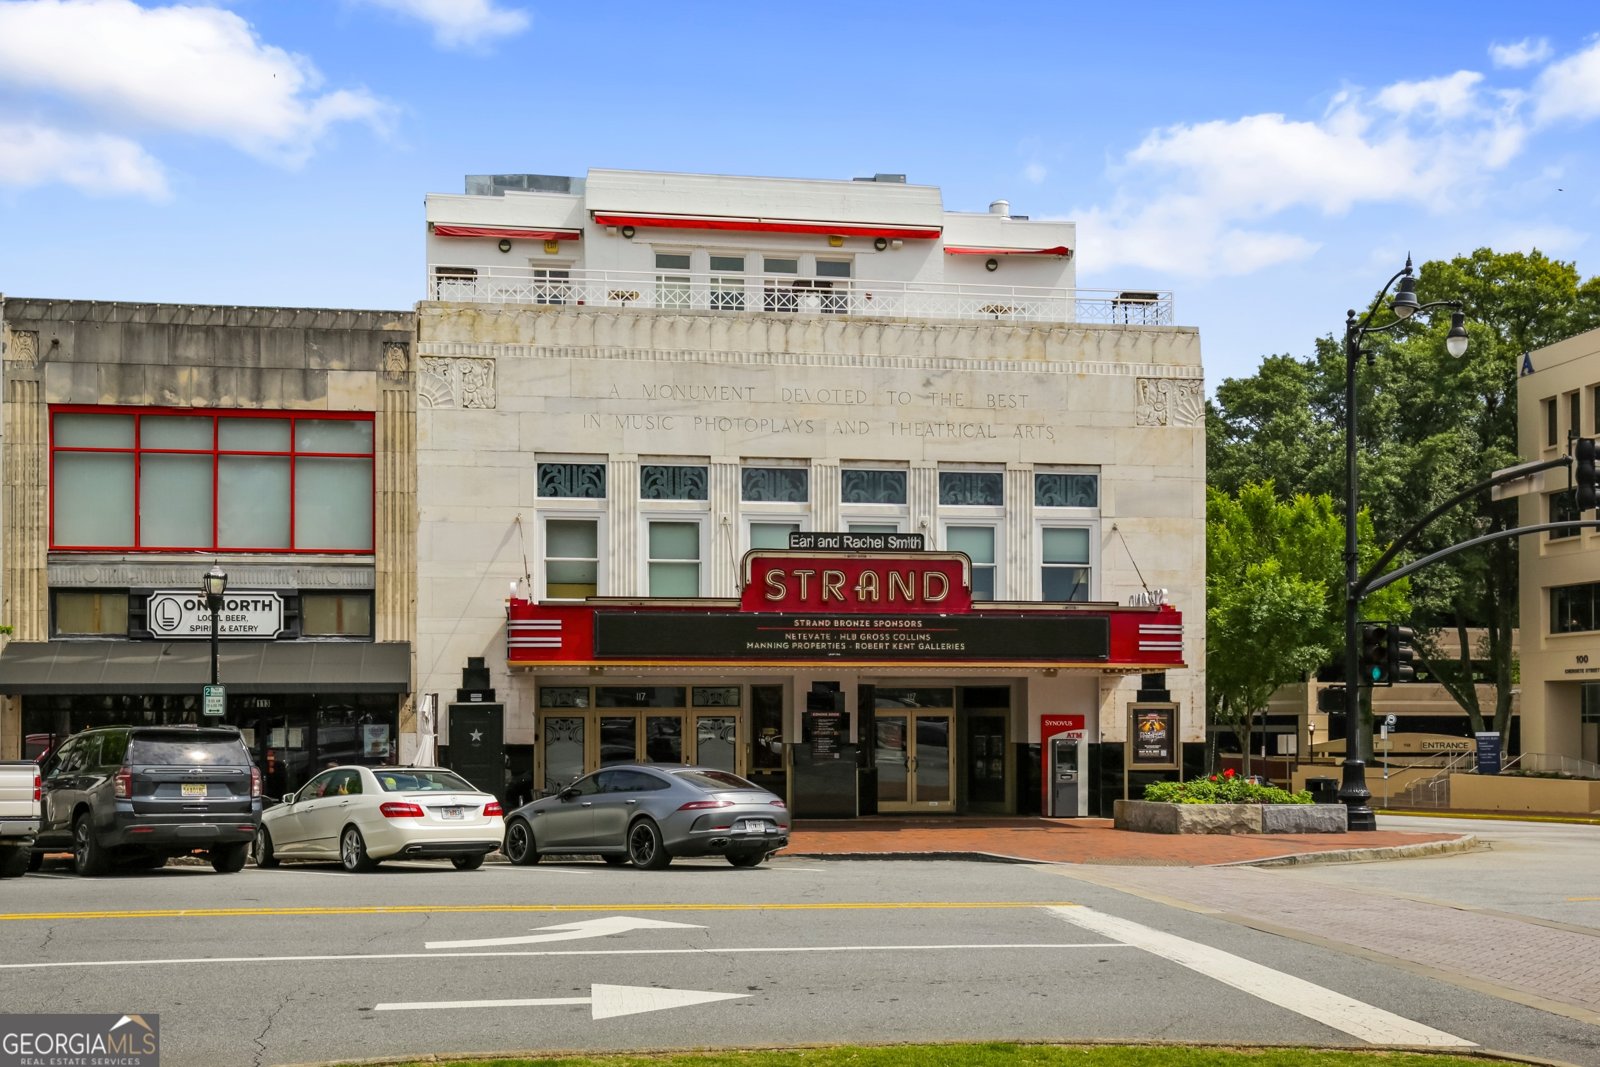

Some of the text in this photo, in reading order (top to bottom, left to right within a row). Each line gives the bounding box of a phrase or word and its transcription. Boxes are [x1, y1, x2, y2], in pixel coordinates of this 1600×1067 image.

[608, 383, 1029, 410] A MONUMENT DEVOTED TO THE BEST
[583, 414, 1055, 441] IN MUSIC PHOTOPLAYS AND THEATRICAL ARTS
[790, 534, 922, 550] Earl and Rachel Smith
[764, 569, 950, 601] STRAND
[184, 599, 209, 611] ON
[197, 614, 249, 623] LOCL BEER,
[219, 624, 227, 632] &
[794, 619, 832, 627] STRAND
[873, 620, 923, 628] SPONSORS
[860, 633, 890, 641] GROSS
[746, 641, 790, 649] MANNING
[792, 642, 846, 650] PROPERTIES
[855, 642, 890, 650] ROBERT
[892, 642, 916, 650] KENT
[1575, 654, 1589, 664] 100
[205, 687, 211, 696] 2
[636, 692, 646, 701] 117
[1044, 719, 1073, 727] SYNOVUS
[1422, 741, 1469, 749] ENTRANCE
